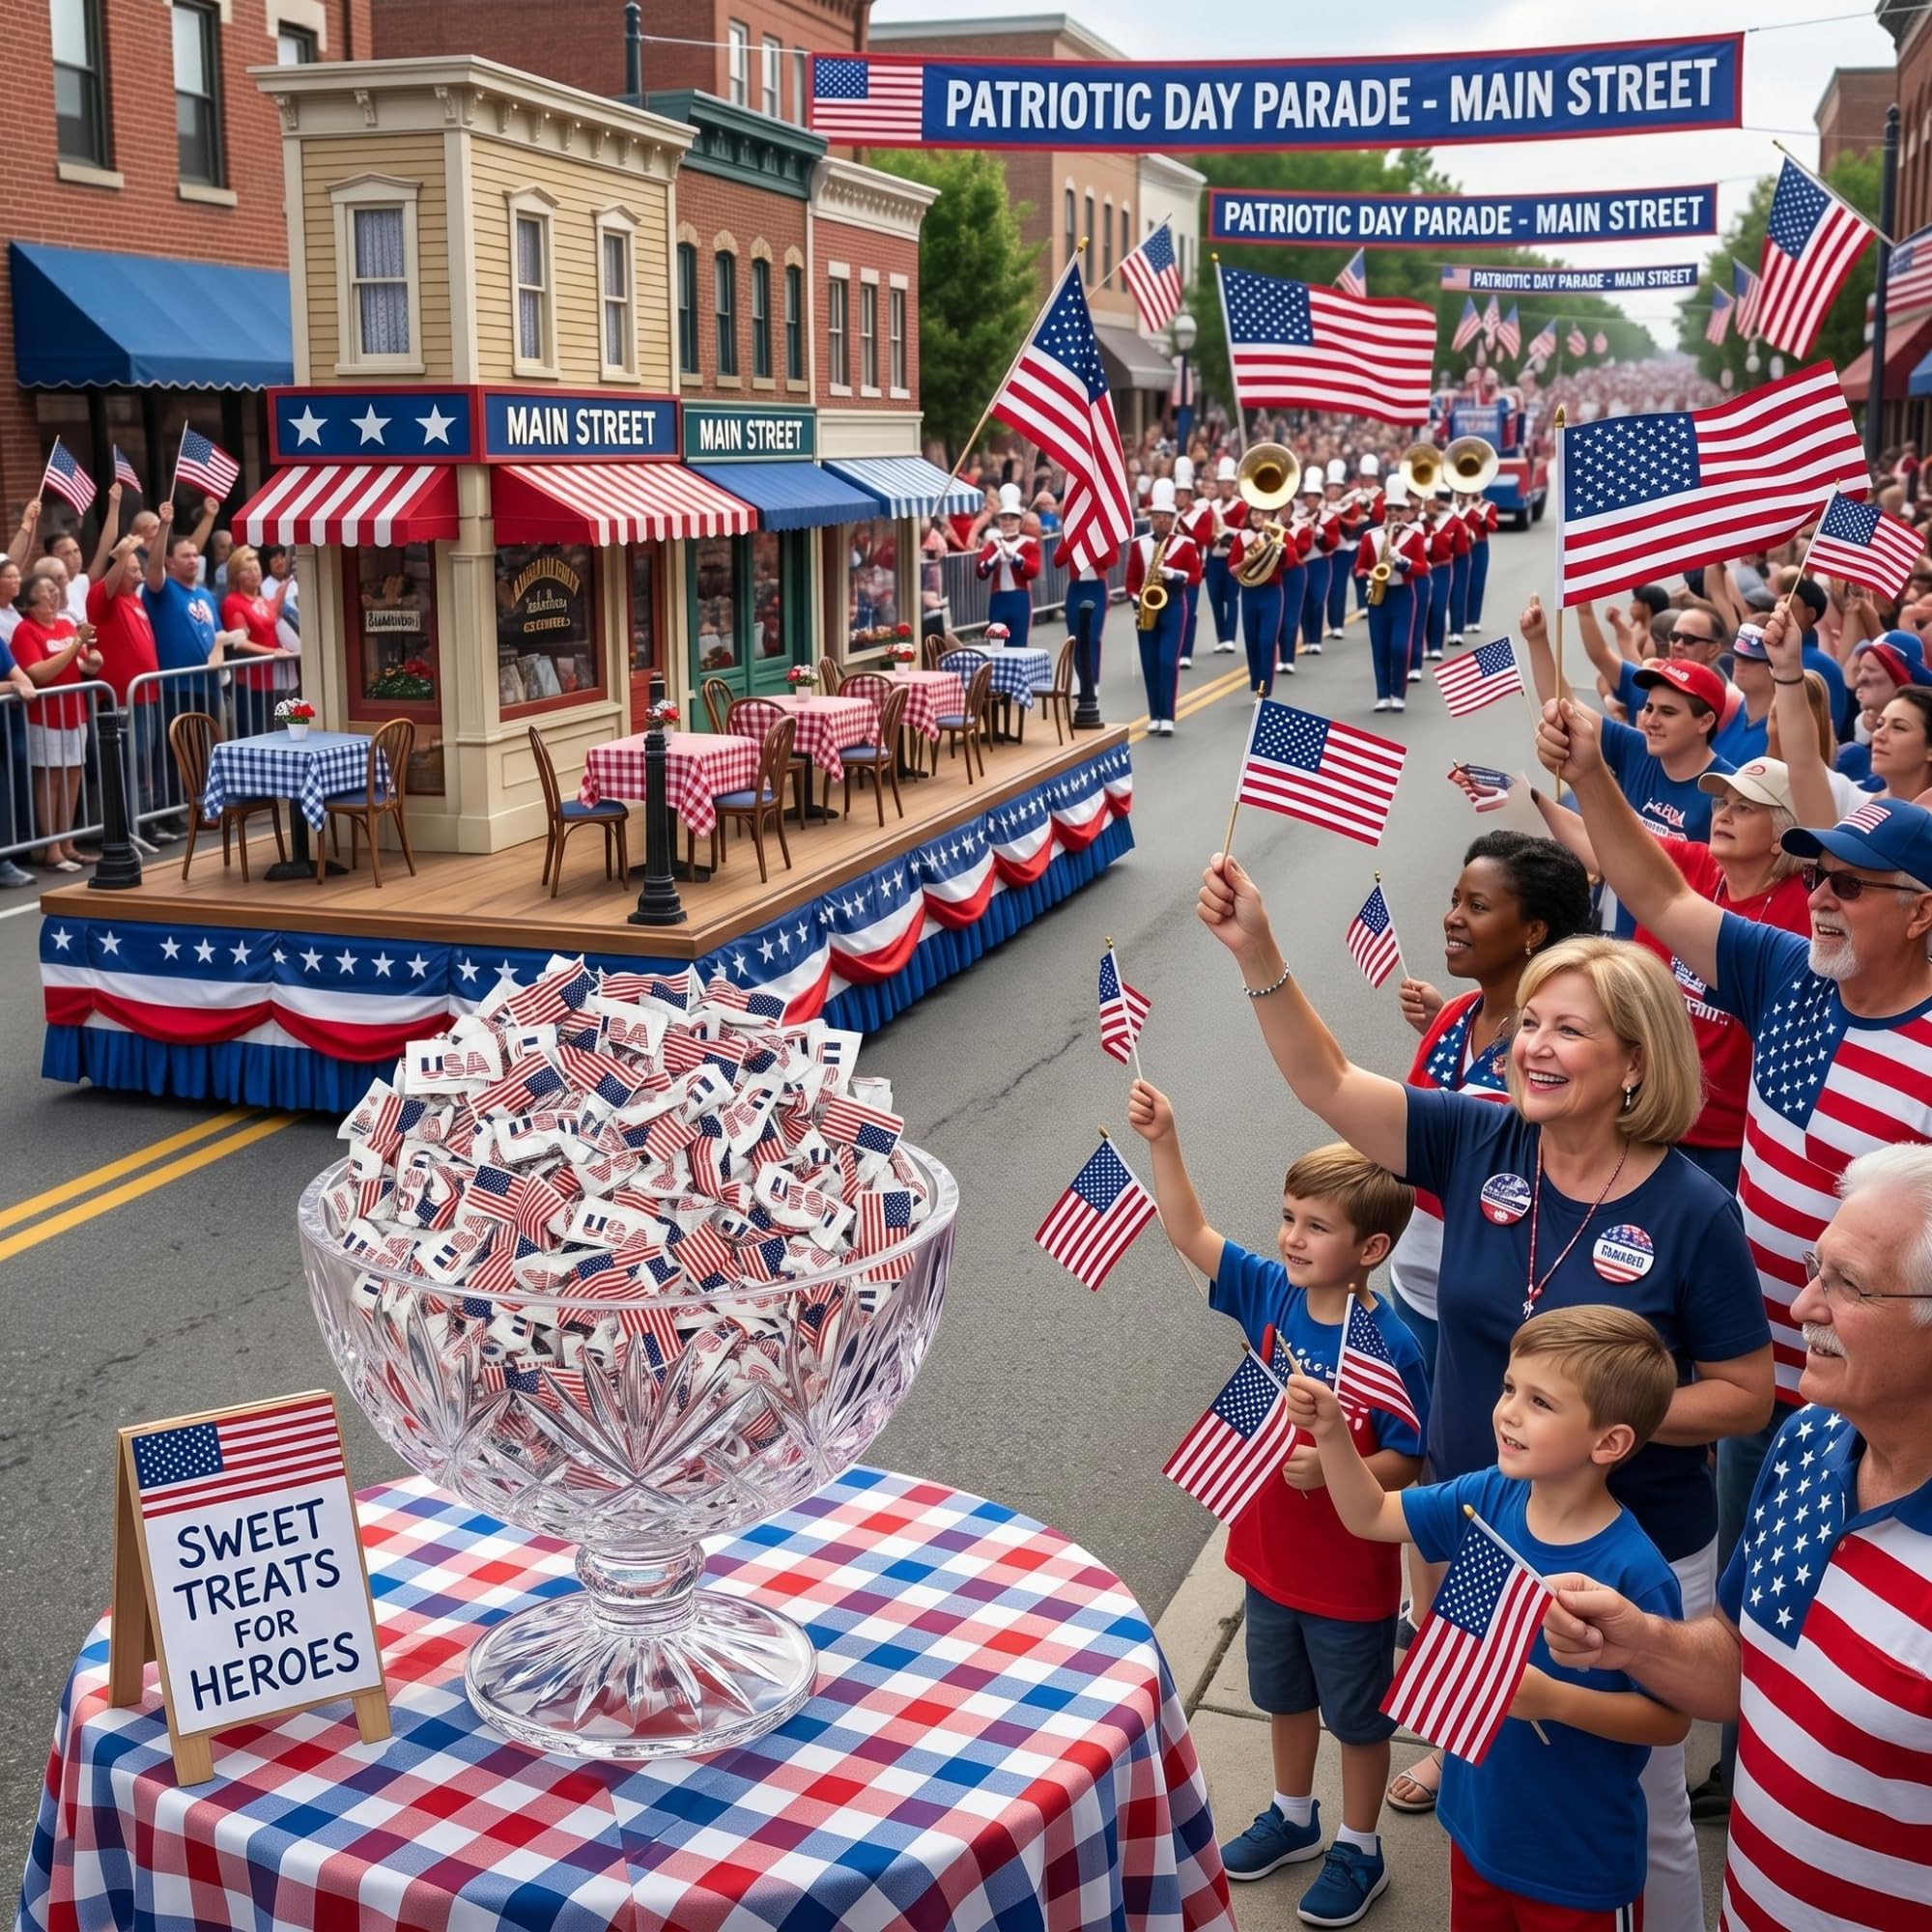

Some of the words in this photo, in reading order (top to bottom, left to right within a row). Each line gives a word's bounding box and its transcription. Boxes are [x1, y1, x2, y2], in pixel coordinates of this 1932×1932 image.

[946, 79, 1152, 130] PATRIOTIC
[1164, 82, 1243, 130] DAY
[1254, 77, 1410, 129] PARADE
[1422, 99, 1437, 109] -
[1450, 70, 1553, 123] MAIN
[1567, 58, 1718, 116] STREET
[1224, 201, 1351, 235] PATRIOTIC
[1358, 206, 1408, 236] DAY
[1413, 205, 1513, 236] PARADE
[1536, 202, 1601, 235] MAIN
[1608, 195, 1704, 231] STREET
[1473, 271, 1530, 289] PATRIOTIC
[1533, 273, 1556, 289] DAY
[1558, 273, 1605, 289] PARADE
[1615, 271, 1645, 287] MAIN
[1648, 269, 1692, 286] STREET
[507, 407, 568, 445] MAIN
[576, 408, 656, 445] STREET
[699, 418, 742, 450] MAIN
[747, 419, 803, 450] STREET
[421, 1051, 491, 1079] USA
[177, 1497, 324, 1568] SWEET
[173, 1548, 340, 1620] TREATS
[234, 1609, 298, 1648] FOR
[190, 1632, 359, 1711] HEROES
